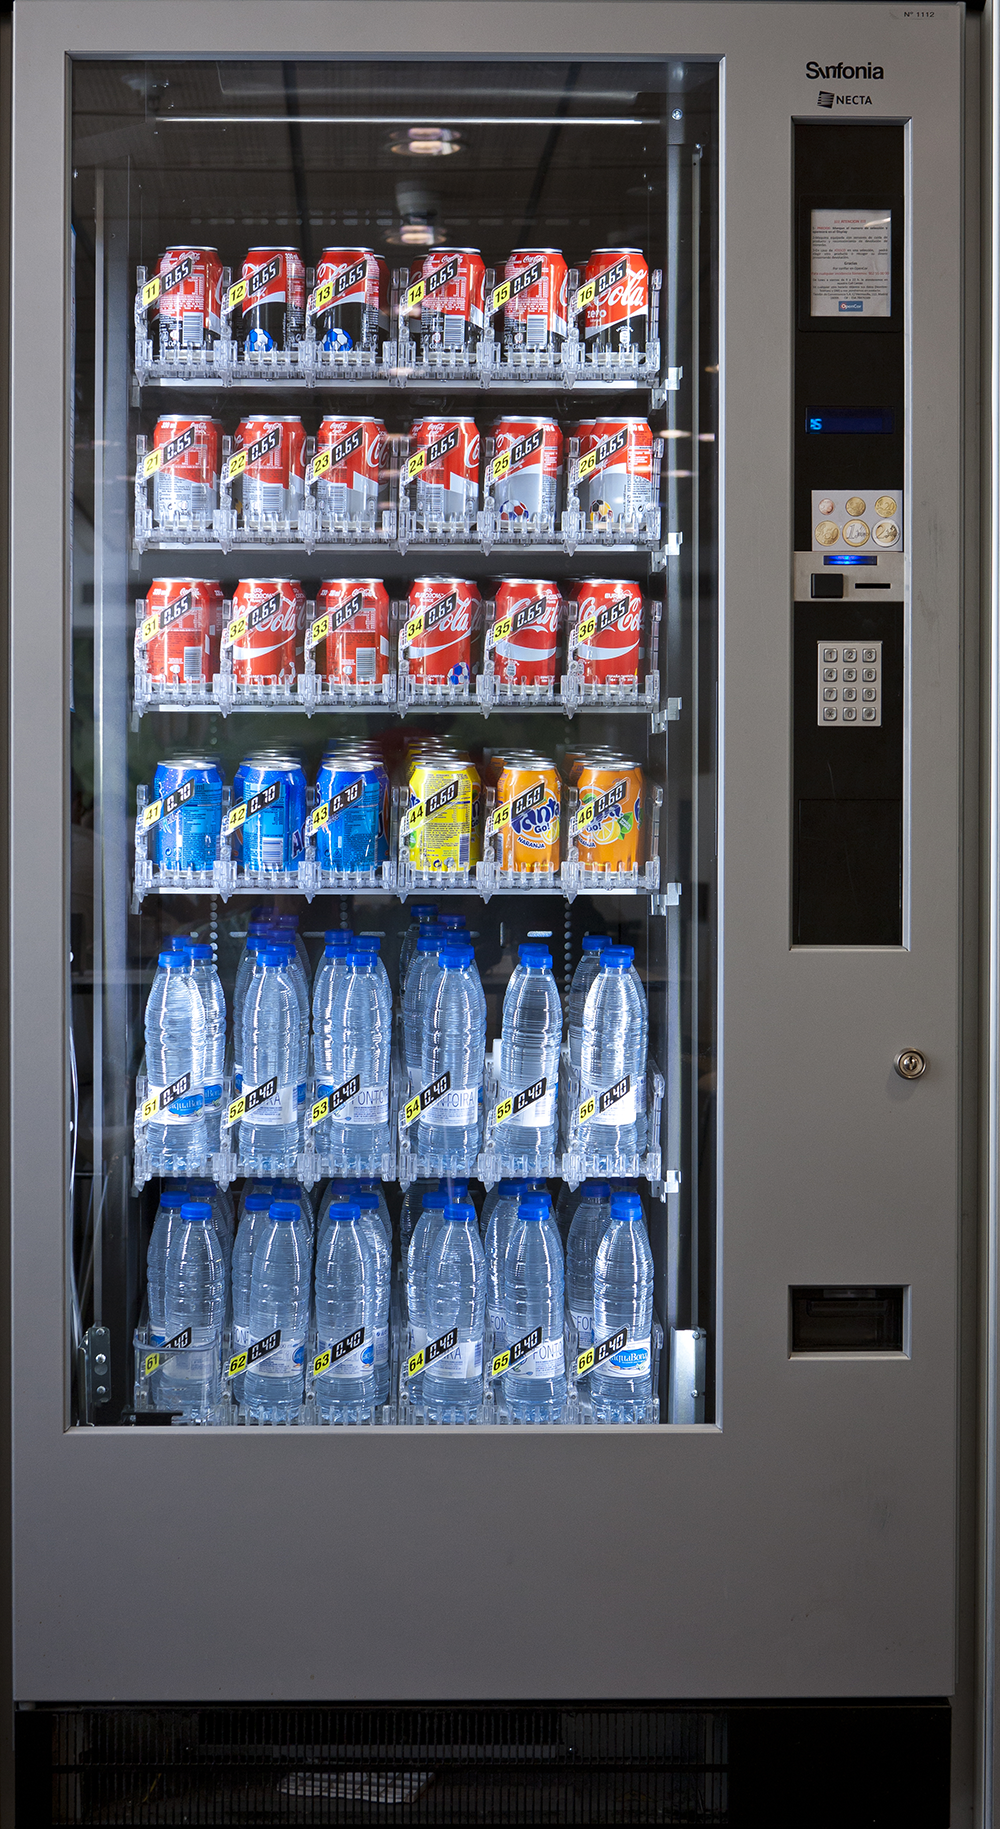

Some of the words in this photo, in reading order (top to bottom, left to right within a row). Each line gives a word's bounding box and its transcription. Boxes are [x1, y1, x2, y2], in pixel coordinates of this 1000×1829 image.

[805, 61, 884, 80] Sinfonia
[836, 95, 873, 105] NECTA
[147, 285, 156, 298] 11
[165, 261, 188, 290] 0.65
[231, 285, 243, 300] 12
[252, 262, 276, 291] 0.65
[318, 286, 330, 301] 13
[339, 265, 363, 291] 0.65
[410, 286, 422, 301] 14
[429, 263, 454, 291] 0.65
[495, 288, 508, 302] 15
[514, 265, 538, 292] 0.65
[580, 286, 592, 302] 16
[599, 264, 623, 291] 0.65
[587, 309, 607, 319] zero
[147, 455, 158, 470] 21
[167, 432, 191, 460] 0.65
[231, 455, 245, 473] 22
[252, 432, 276, 461] 0.65
[315, 455, 328, 472] 23
[335, 432, 359, 461] 0.65
[410, 455, 423, 473] 24
[431, 432, 455, 460] 0.65
[495, 455, 508, 473] 25
[515, 433, 540, 461] 0.65
[580, 455, 594, 473] 26
[600, 433, 624, 460] 0.65
[145, 620, 156, 636] 31
[164, 597, 188, 624] 0.65
[230, 620, 244, 637] 32
[252, 598, 276, 626] 0.65
[313, 620, 327, 637] 33
[335, 598, 359, 626] 0.65
[408, 620, 422, 637] 34
[428, 596, 453, 623] 0.65
[495, 621, 509, 637] 35
[517, 601, 542, 627] 0.65
[579, 620, 594, 637] 36
[601, 601, 625, 628] 0.65
[848, 710, 853, 718] 0
[146, 807, 158, 821] 41
[167, 783, 190, 812] 0.70
[230, 808, 245, 824] 42
[251, 786, 275, 813] 0.70
[314, 807, 327, 824] 43
[333, 785, 357, 811] 0.70
[410, 806, 423, 823] 44
[430, 785, 455, 812] 0.60
[494, 808, 508, 824] 45
[516, 786, 541, 814] 0.60
[579, 807, 592, 823] 46
[599, 785, 623, 810] 0.60
[518, 837, 545, 849] NARANJA
[534, 823, 551, 833] Go!
[145, 1100, 156, 1115] 51
[163, 1077, 186, 1104] 0.40
[230, 1100, 244, 1119] 52
[249, 1081, 274, 1107] 0.40
[313, 1103, 327, 1119] 53
[333, 1079, 356, 1105] 0.40
[407, 1103, 420, 1119] 54
[424, 1077, 447, 1103] 0.40
[497, 1101, 511, 1119] 55
[518, 1081, 542, 1108] 0.40
[580, 1103, 594, 1119] 56
[604, 1080, 627, 1108] 0.40
[147, 1354, 158, 1369] 61
[230, 1356, 245, 1371] 62
[252, 1333, 276, 1357] 0.40
[315, 1353, 329, 1371] 63
[335, 1330, 360, 1357] 0.40
[409, 1356, 423, 1371] 64
[430, 1332, 453, 1357] 0.40
[494, 1354, 508, 1371] 65
[514, 1331, 538, 1358] 0.40
[579, 1351, 592, 1369] 66
[599, 1333, 623, 1358] 0.40
